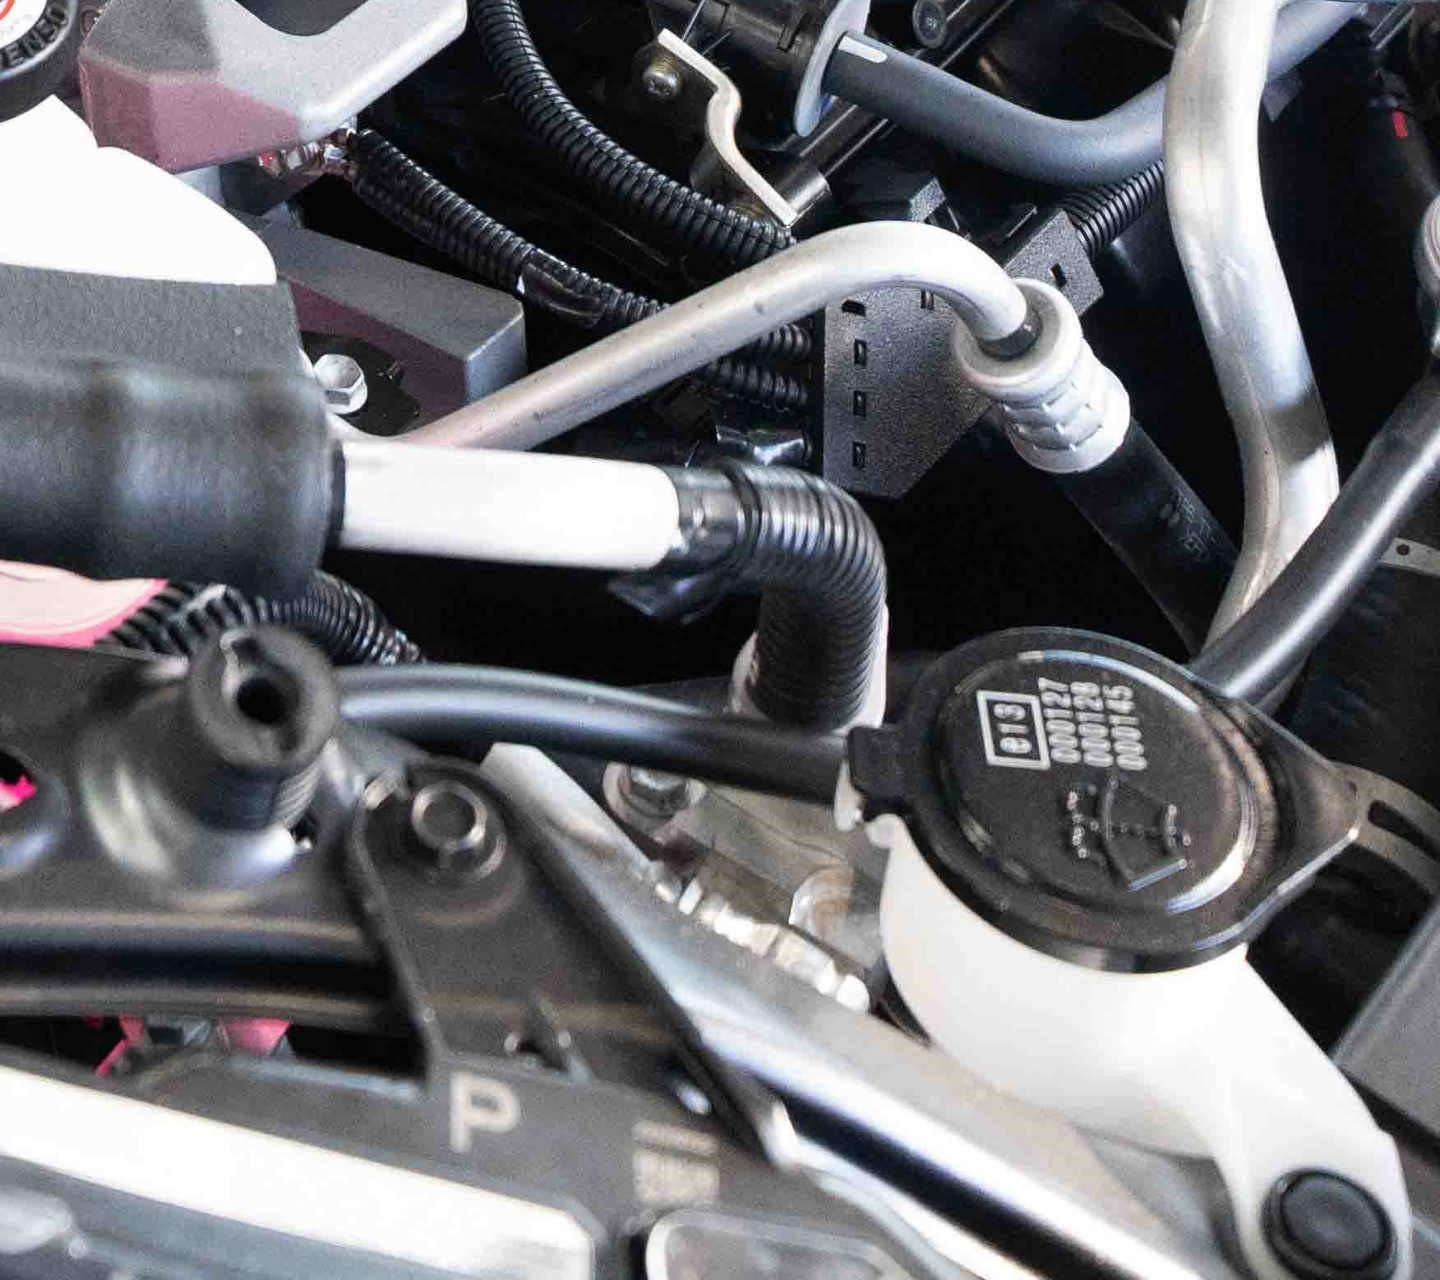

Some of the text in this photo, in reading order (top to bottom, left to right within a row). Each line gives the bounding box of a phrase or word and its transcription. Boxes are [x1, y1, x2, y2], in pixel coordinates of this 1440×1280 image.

[993, 703, 1032, 754] e13
[1038, 677, 1081, 764] 000127
[1070, 681, 1114, 768] 000128
[1102, 685, 1147, 771] 000145
[450, 1072, 519, 1153] P
